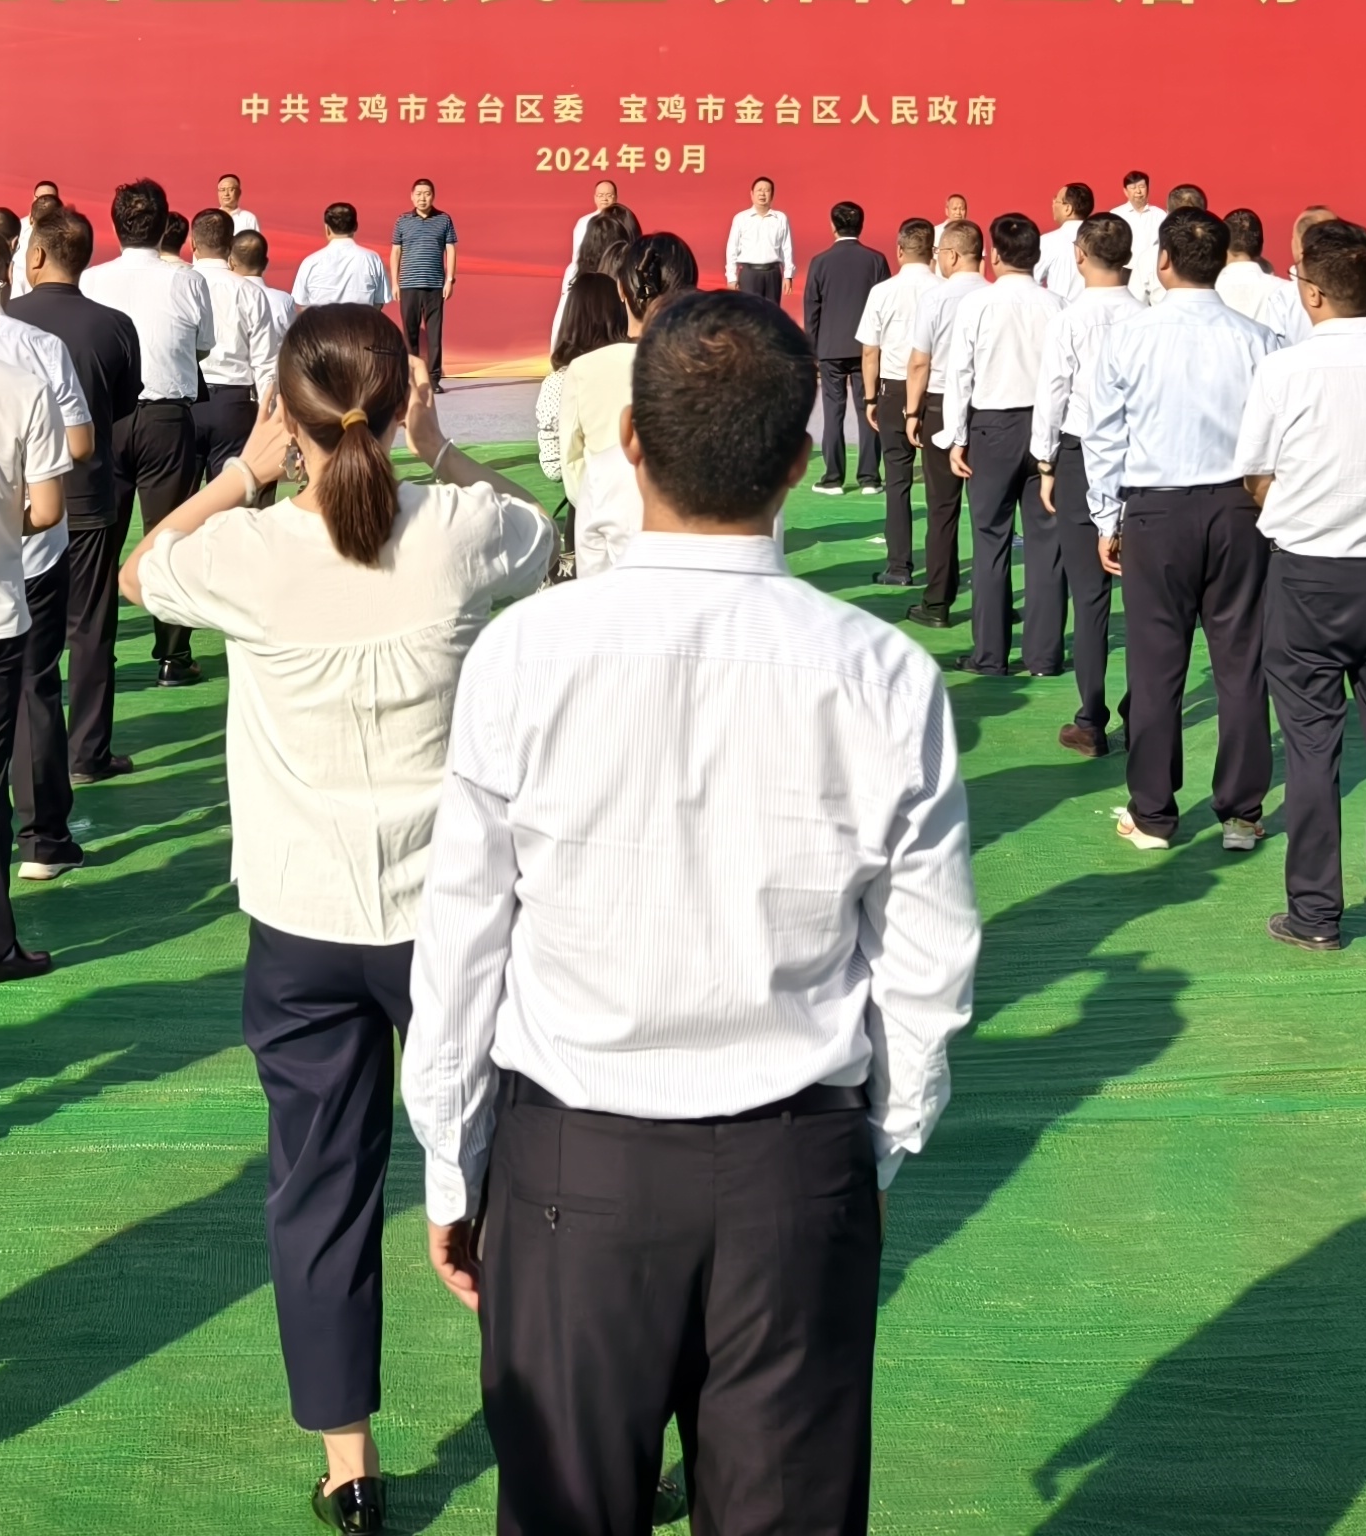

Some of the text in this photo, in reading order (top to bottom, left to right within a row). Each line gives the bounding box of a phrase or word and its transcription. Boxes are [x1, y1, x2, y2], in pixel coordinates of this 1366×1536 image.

[241, 93, 997, 125] 中共宝鸡市金台区委 宝鸡市金台区人民政府
[536, 144, 705, 174] 2024年9月
